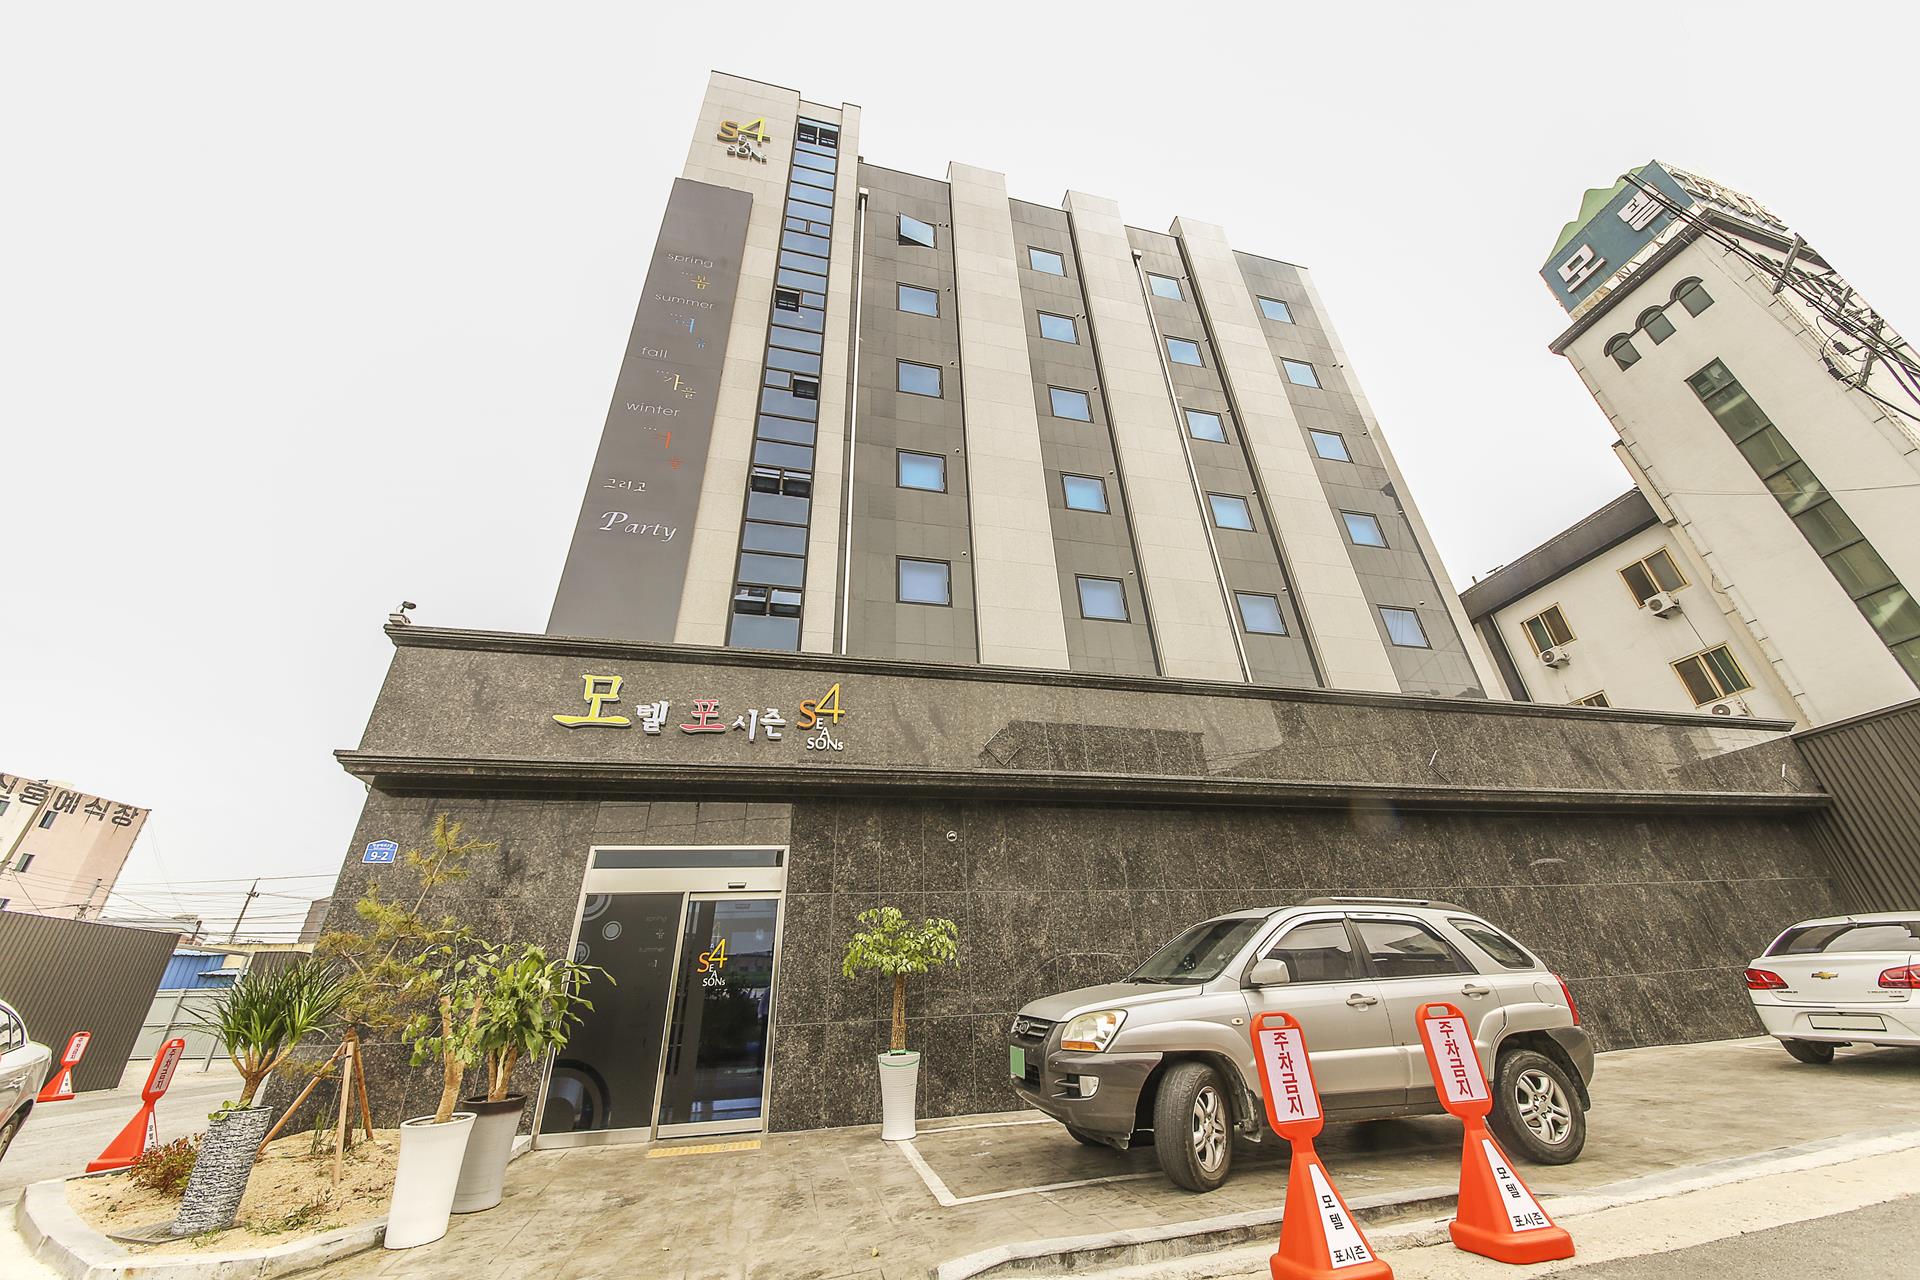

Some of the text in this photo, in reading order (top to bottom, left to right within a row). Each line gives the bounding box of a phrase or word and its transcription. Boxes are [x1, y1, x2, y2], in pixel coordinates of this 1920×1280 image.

[667, 252, 714, 269] spring
[654, 293, 715, 310] summer
[641, 347, 668, 359] fall
[626, 401, 680, 417] winter
[603, 478, 647, 492] 그리고
[600, 511, 677, 542] Party
[551, 674, 787, 742] 모텔 포시즌
[370, 851, 389, 860] 9-2
[1438, 1020, 1475, 1099] 주차금지
[1272, 1031, 1305, 1117] 주차금지
[1496, 1166, 1521, 1199] 모텔
[1321, 1194, 1345, 1231] 모텔
[1512, 1211, 1545, 1228] 포시즌
[1333, 1245, 1366, 1264] 포시즌
